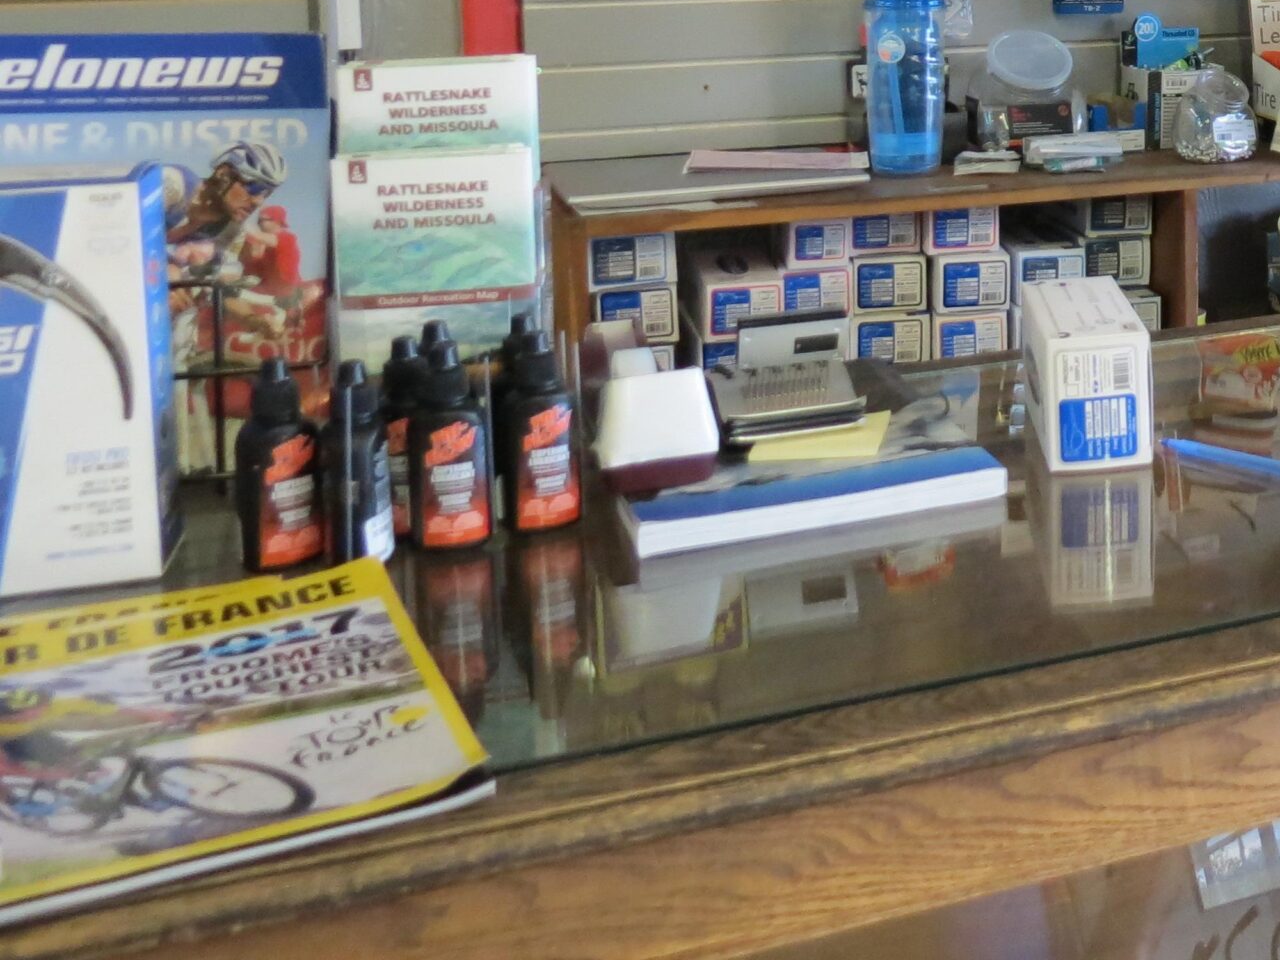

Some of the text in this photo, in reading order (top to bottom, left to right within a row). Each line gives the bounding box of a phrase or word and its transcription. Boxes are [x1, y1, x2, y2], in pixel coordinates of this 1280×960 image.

[0, 43, 283, 90] elonews
[382, 87, 492, 104] RATTLESNAKE
[1253, 83, 1276, 110] Tire
[388, 103, 487, 119] WILDERNESS
[0, 118, 309, 151] NE & DUSTED
[378, 118, 499, 136] AND MISSOULA
[377, 180, 489, 197] RATTLESNAKE
[382, 196, 485, 213] WILDERNESS
[372, 213, 496, 230] AND MISSOULA
[377, 290, 499, 306] Outdoor Recreation Map
[65, 625, 131, 653] DE
[152, 575, 357, 637] FRANCE
[146, 606, 363, 674] 2017
[276, 658, 383, 695] TOUR
